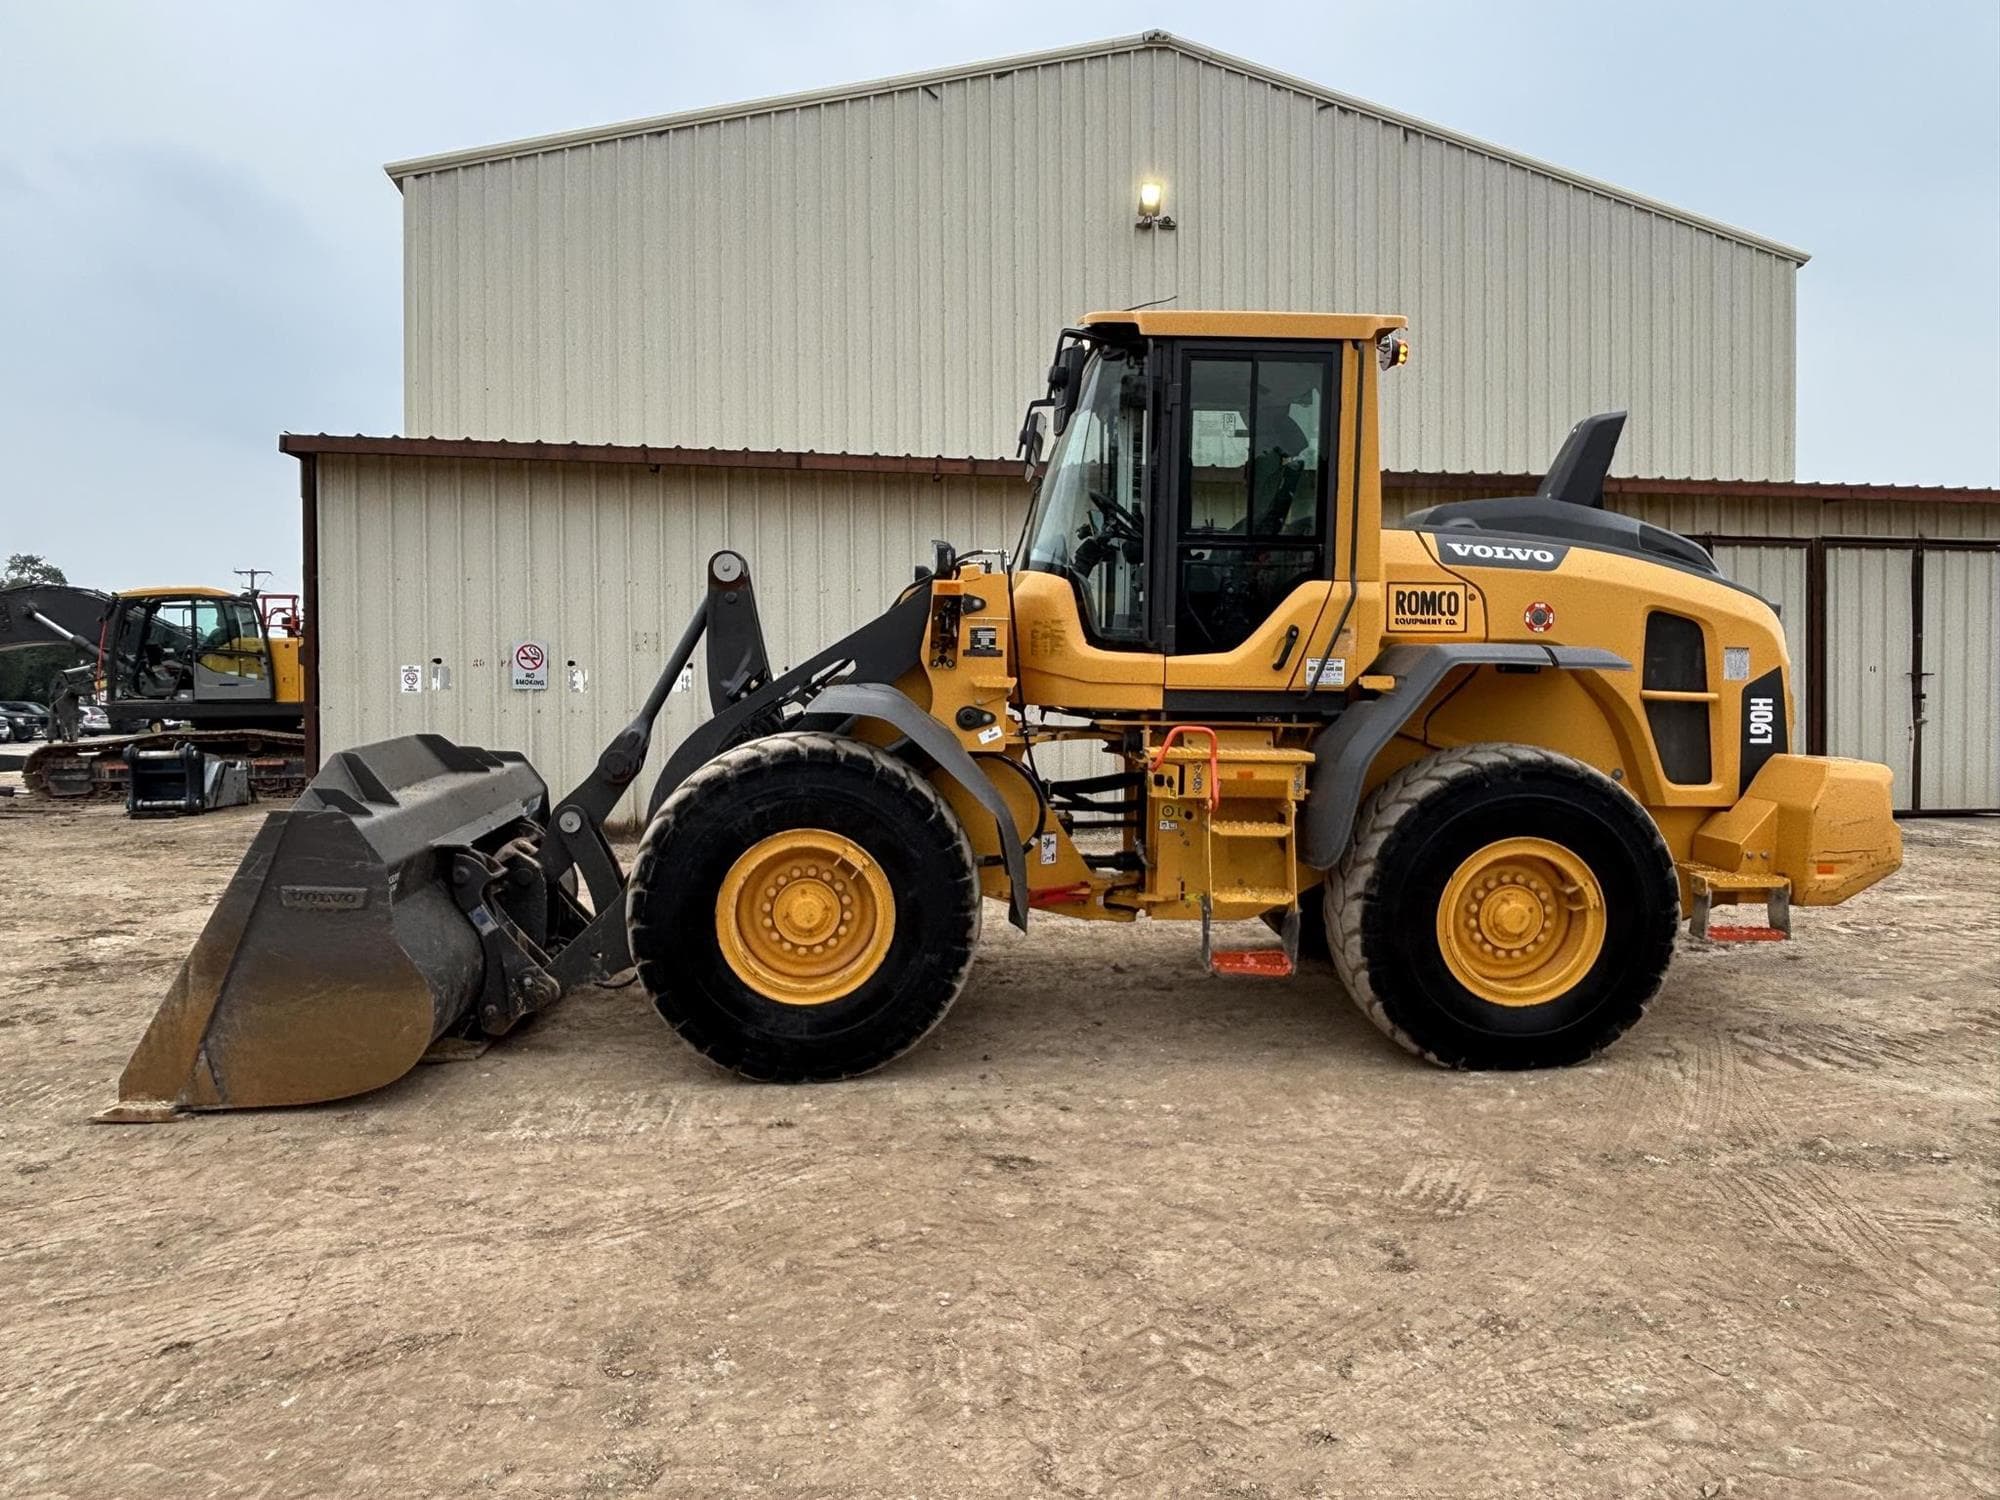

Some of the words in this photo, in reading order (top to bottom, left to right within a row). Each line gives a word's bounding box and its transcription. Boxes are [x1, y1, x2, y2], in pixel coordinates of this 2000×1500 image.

[1446, 543, 1554, 563] VOLVO
[1395, 590, 1459, 616] ROMCO
[1395, 617, 1442, 625] EQUIPMENT
[1750, 698, 1773, 744] L90H
